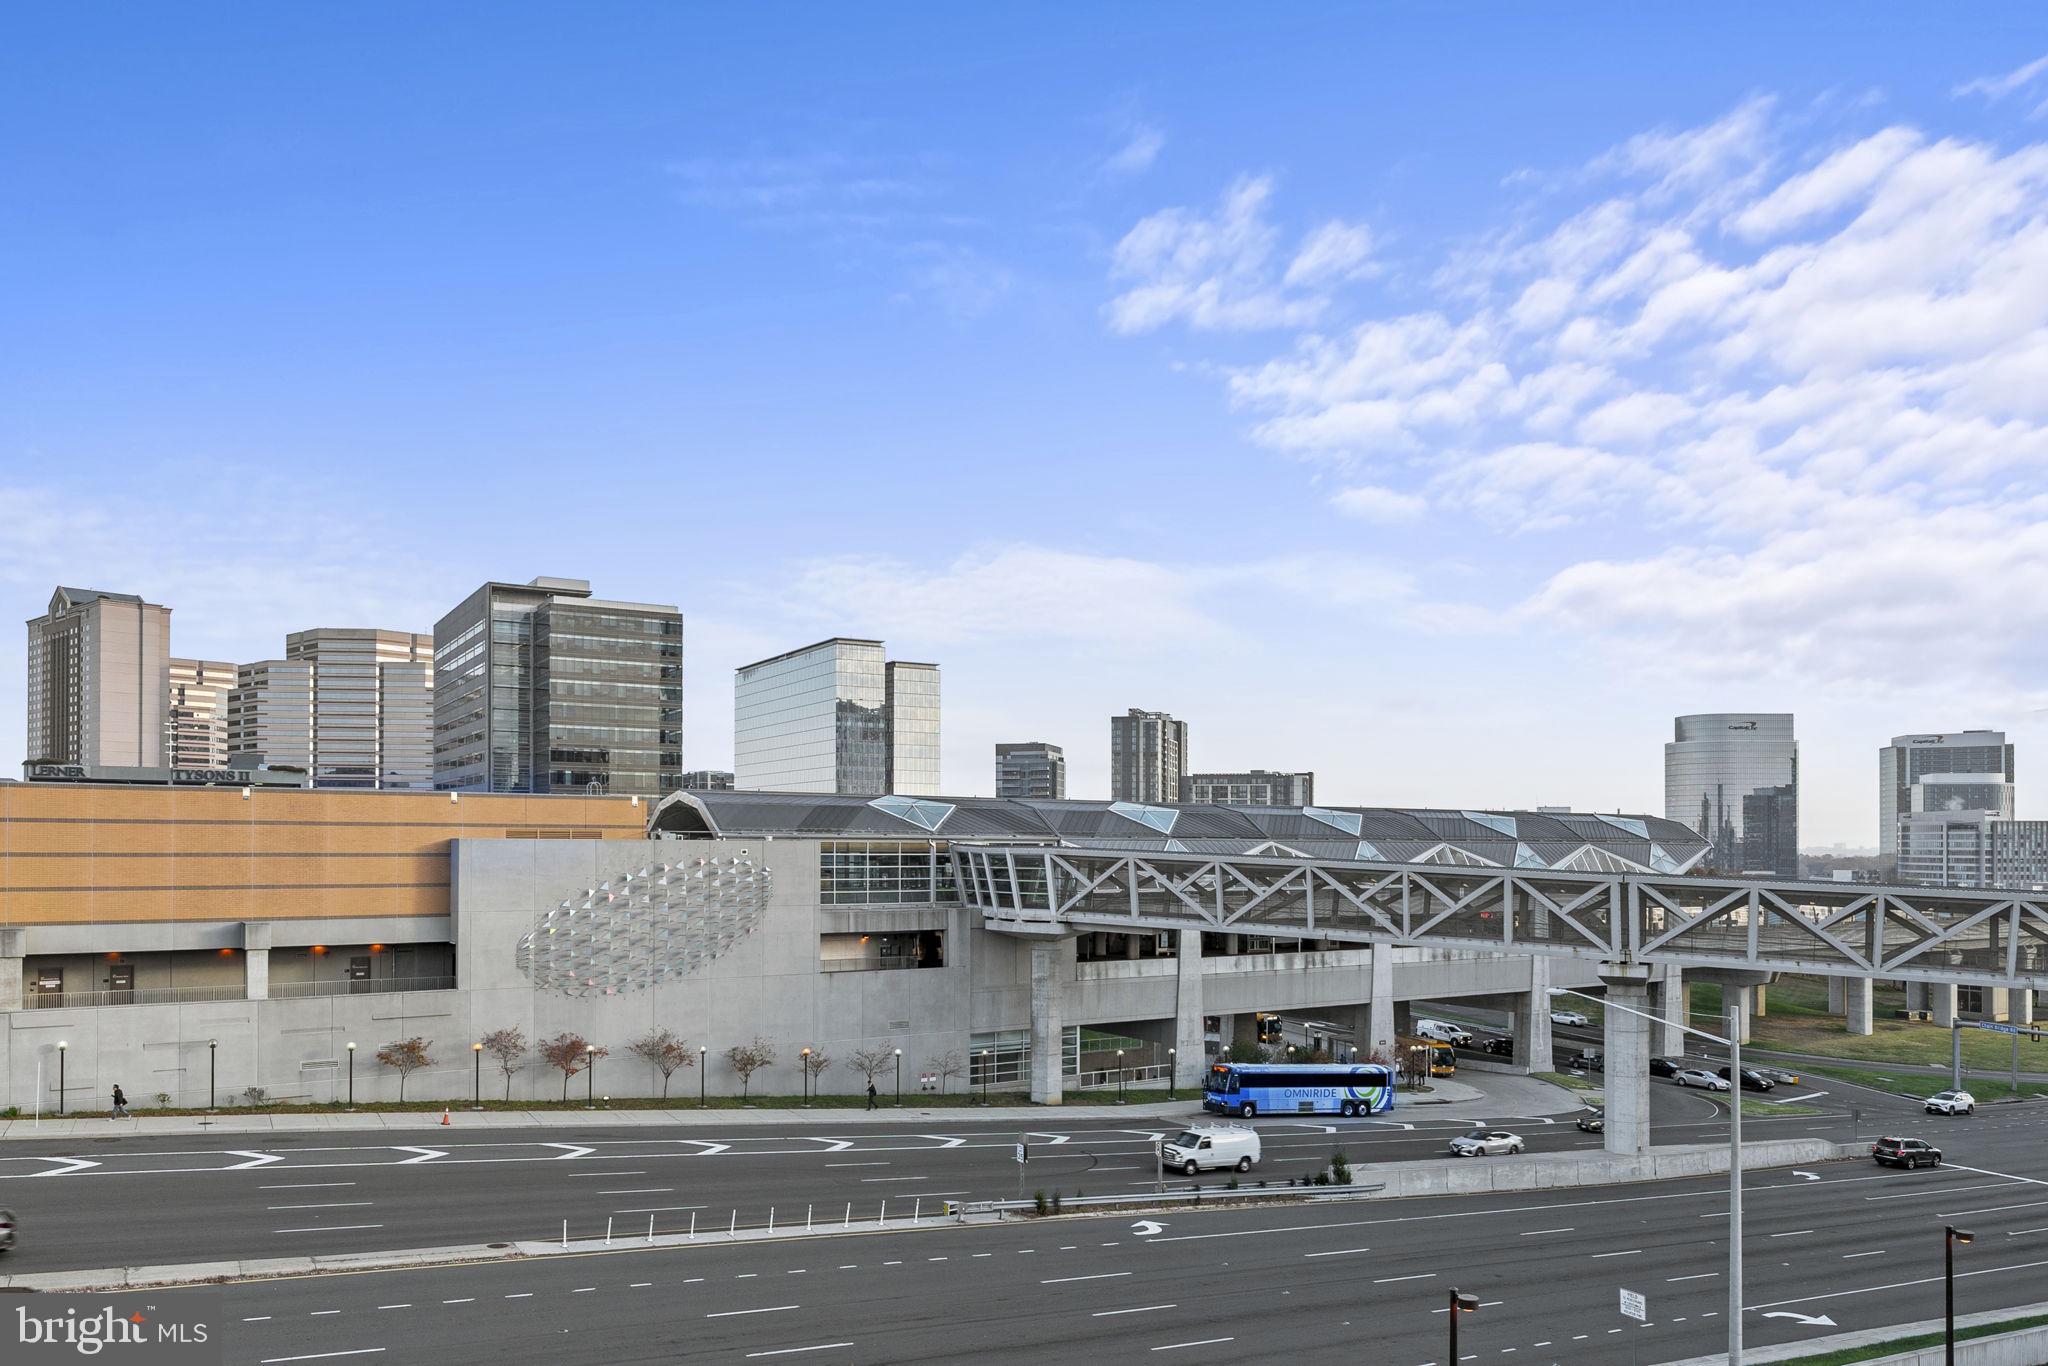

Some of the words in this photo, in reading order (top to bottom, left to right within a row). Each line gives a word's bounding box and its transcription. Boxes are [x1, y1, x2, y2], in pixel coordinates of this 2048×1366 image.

[31, 765, 87, 777] LERNER
[173, 768, 236, 781] TYSONS
[238, 771, 251, 781] II
[1284, 1088, 1337, 1098] OMNIRIDE
